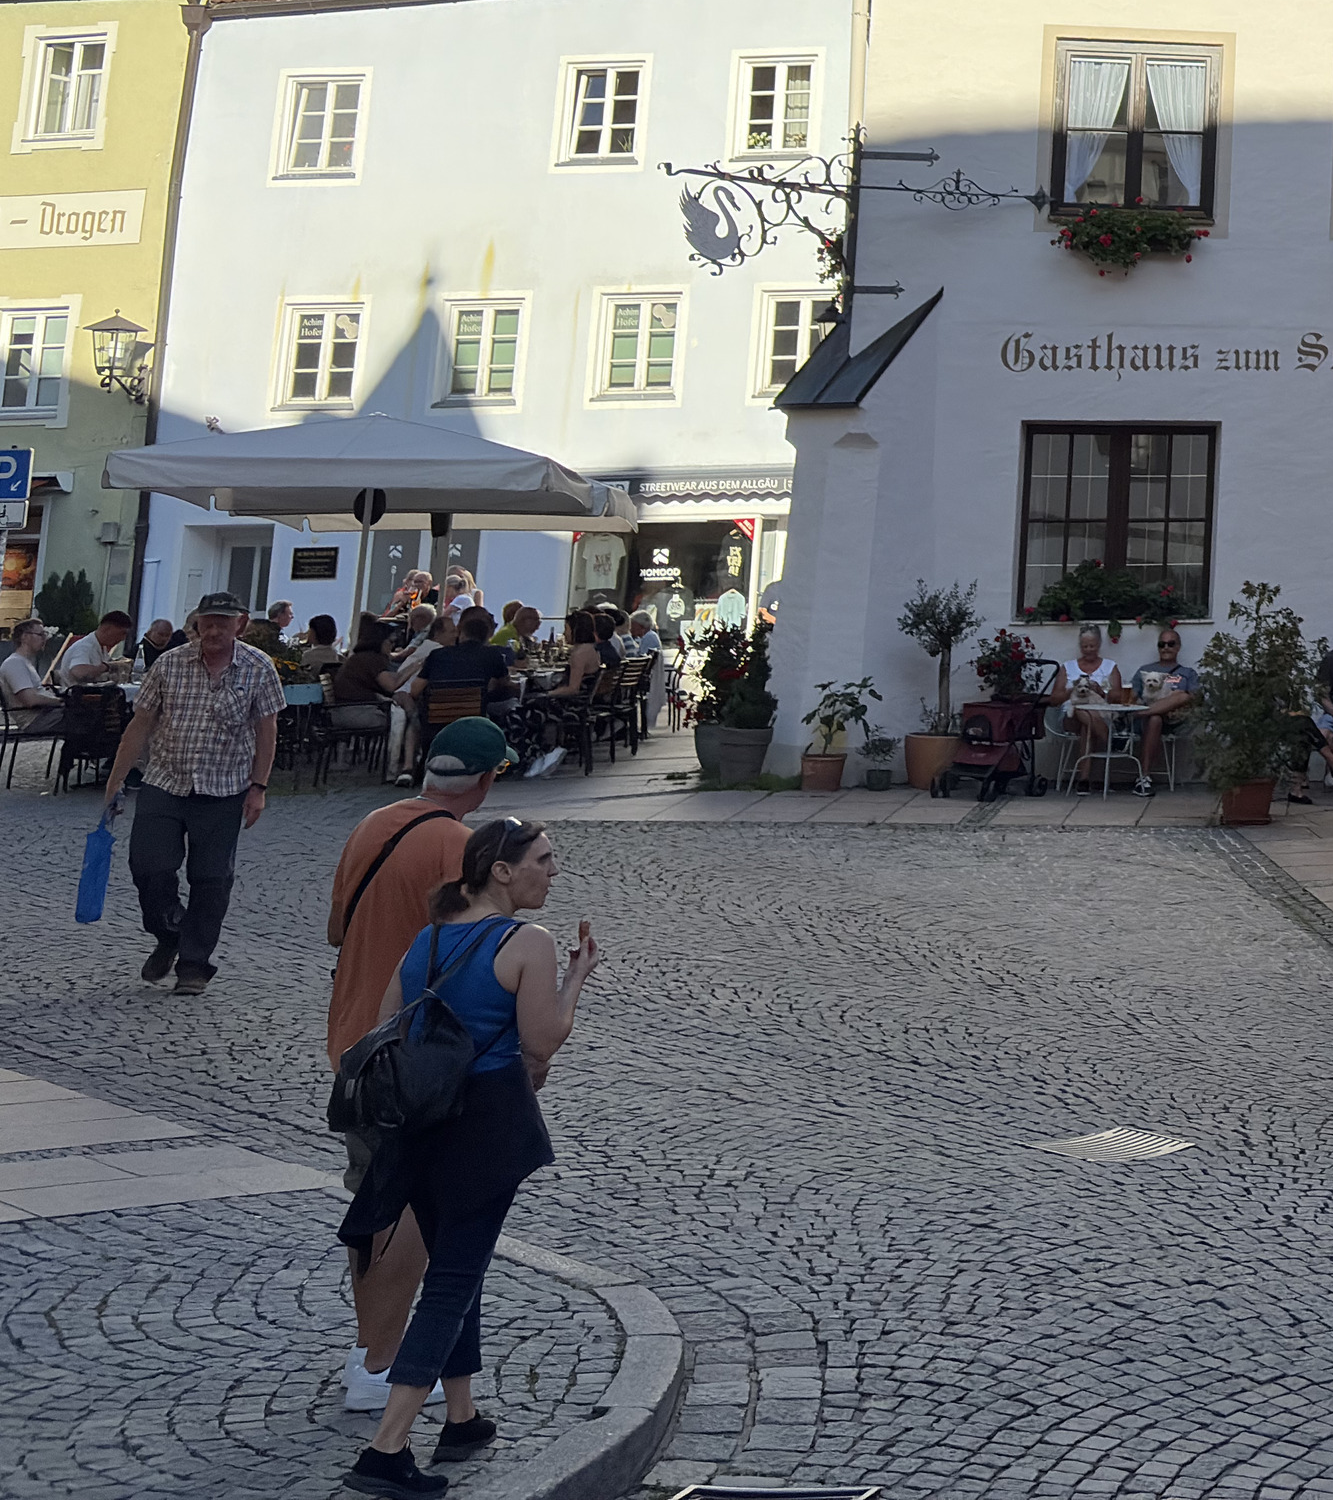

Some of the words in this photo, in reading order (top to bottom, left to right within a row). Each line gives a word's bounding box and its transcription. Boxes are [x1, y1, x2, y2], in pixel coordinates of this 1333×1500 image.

[39, 201, 127, 241] Drogen
[616, 307, 639, 315] Achim
[302, 318, 323, 326] Achim
[460, 313, 483, 322] Achim
[615, 317, 638, 326] Hofer
[301, 328, 323, 336] Hofer
[460, 323, 481, 332] Hofer
[1000, 330, 1200, 382] Gasthaus
[1214, 346, 1280, 372] zum
[639, 481, 697, 492] STREETWEAR
[698, 480, 717, 490] AUS
[719, 479, 740, 490] DEM
[741, 478, 778, 489] ALLGÄU
